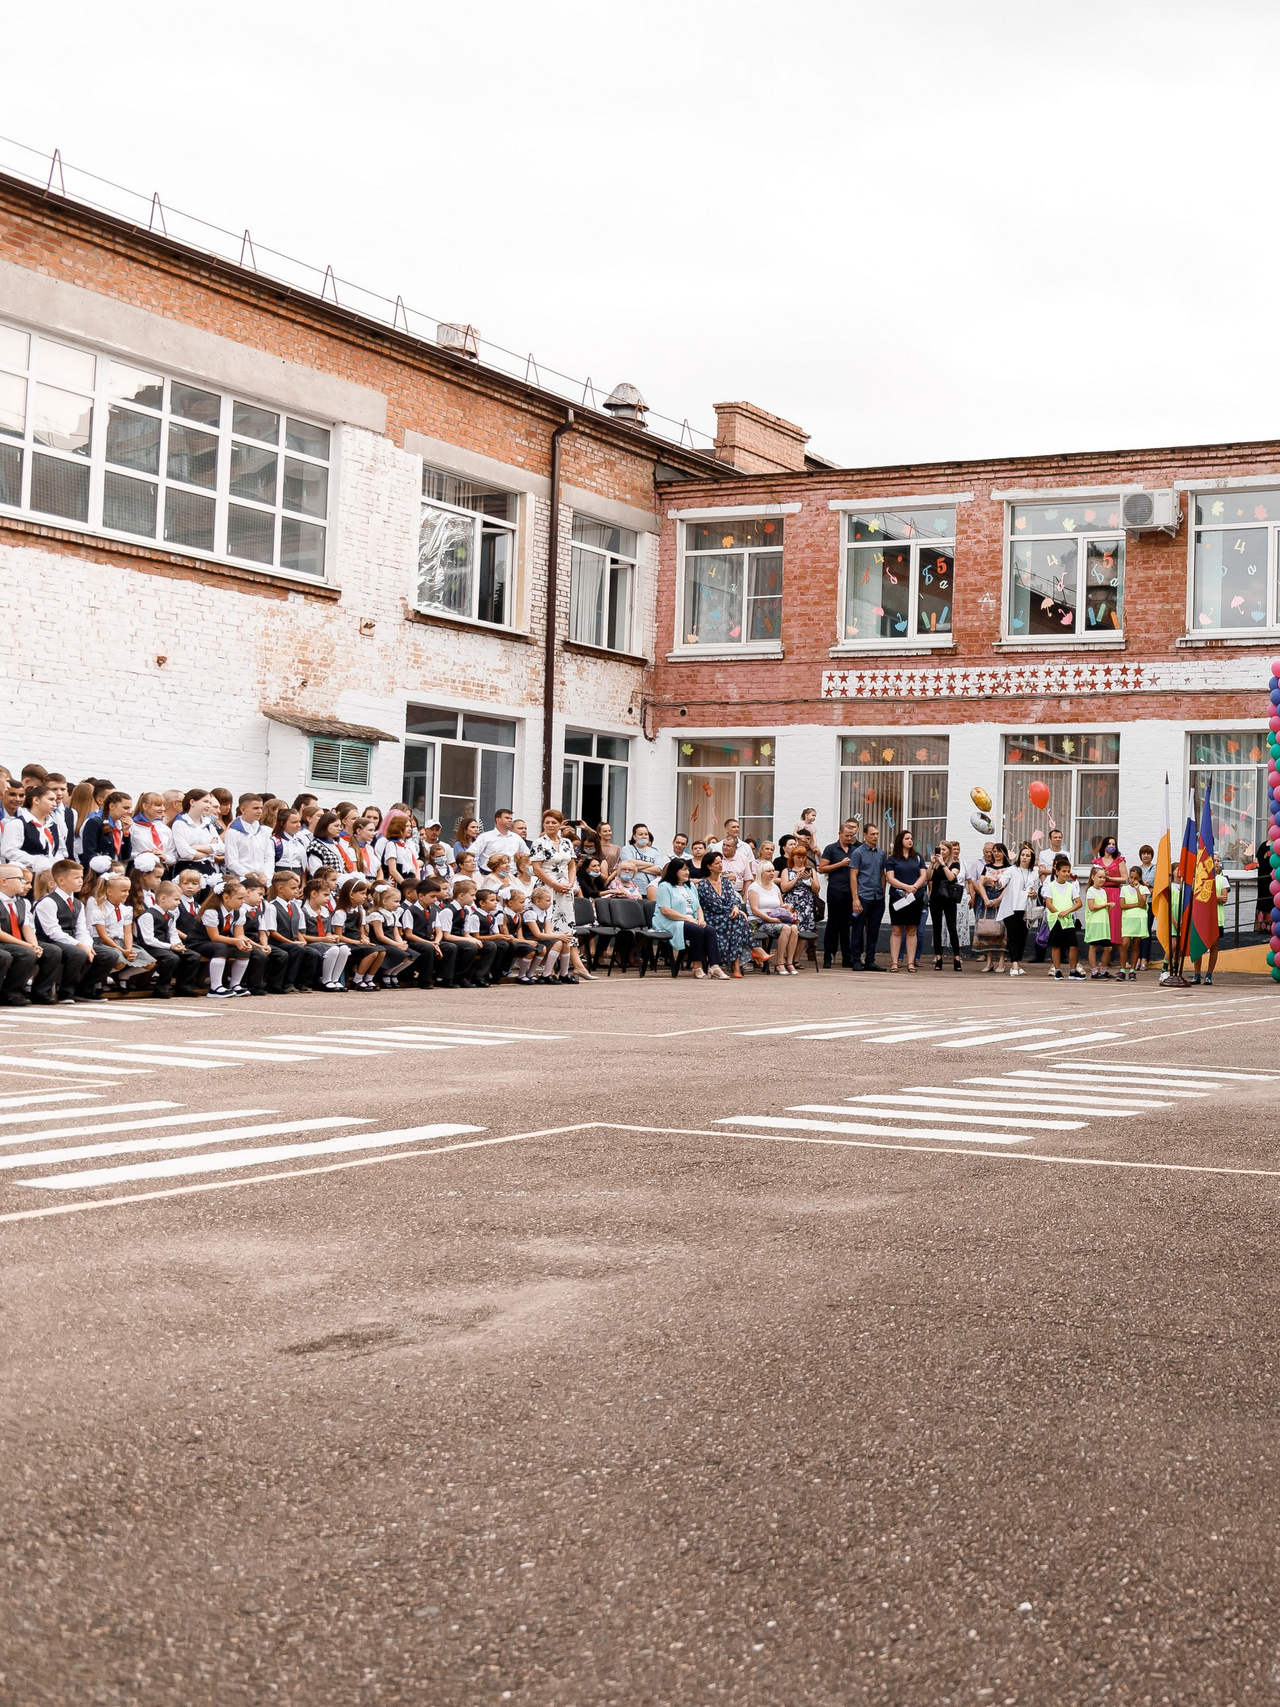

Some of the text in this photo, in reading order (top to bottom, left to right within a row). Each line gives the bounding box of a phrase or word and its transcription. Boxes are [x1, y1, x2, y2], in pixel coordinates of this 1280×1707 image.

[1234, 539, 1246, 554] 4
[873, 553, 884, 564] 4
[937, 557, 947, 574] 5
[1046, 554, 1059, 567] 4
[1103, 551, 1114, 568] 5
[702, 782, 714, 798] 5
